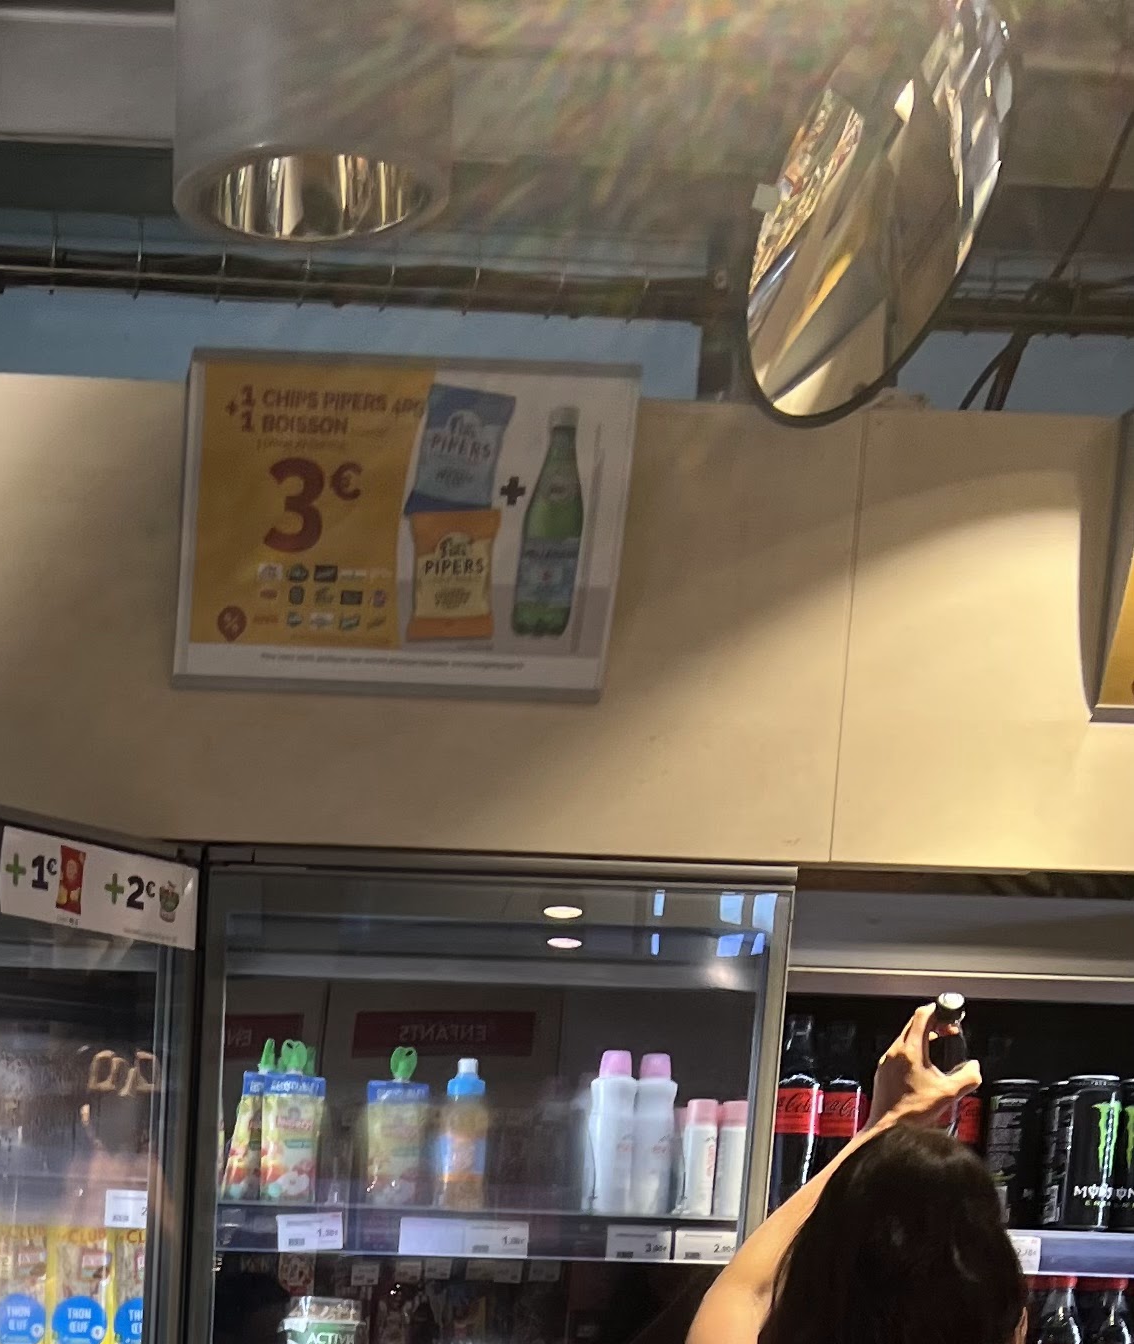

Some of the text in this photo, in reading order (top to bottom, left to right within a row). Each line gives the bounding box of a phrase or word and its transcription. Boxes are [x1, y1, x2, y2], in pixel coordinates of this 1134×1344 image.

[262, 388, 319, 411] CHIPS
[322, 390, 387, 414] PIPERS
[261, 414, 348, 435] BOISSON
[428, 431, 492, 460] PIPERS
[424, 557, 485, 577] PIPERS
[126, 1230, 145, 1244] CL
[7, 1305, 30, 1317] THON
[67, 1307, 92, 1319] THON
